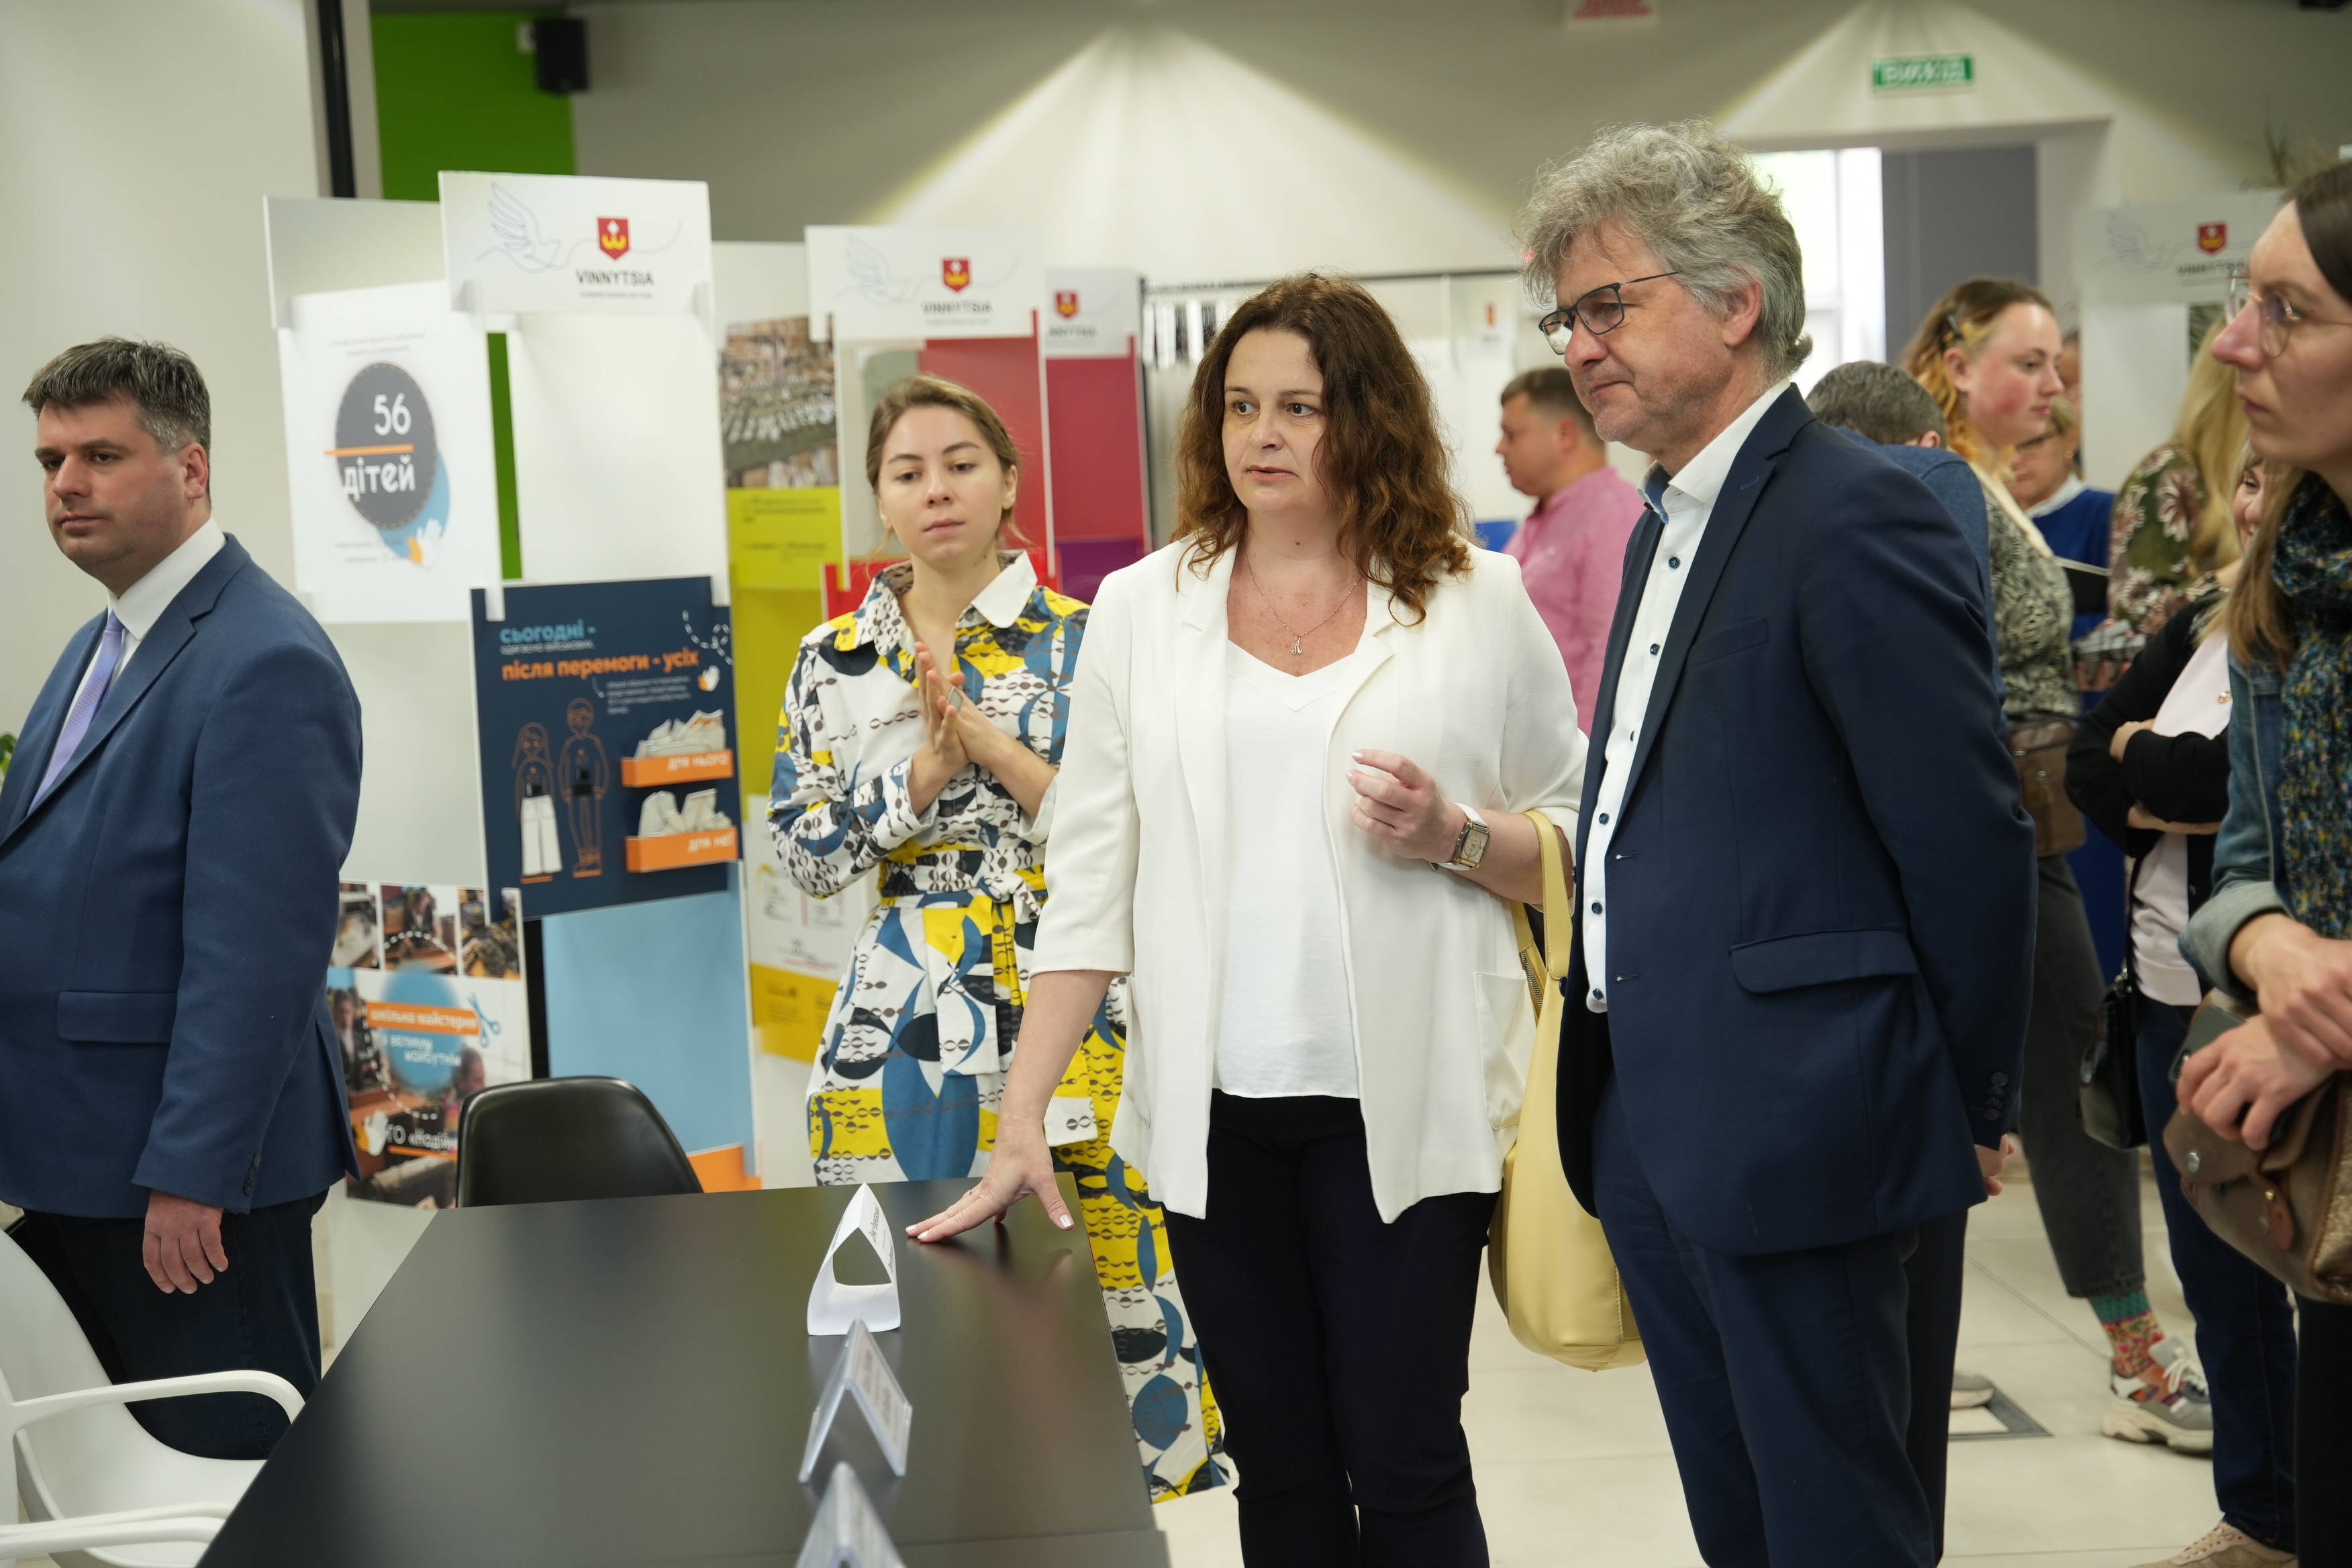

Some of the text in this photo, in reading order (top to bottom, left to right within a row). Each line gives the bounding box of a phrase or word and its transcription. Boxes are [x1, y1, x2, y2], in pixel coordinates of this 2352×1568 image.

[575, 268, 654, 285] VINNYTSIA
[374, 392, 411, 436] 56
[344, 454, 415, 502] дітей
[499, 618, 584, 644] сьогодні
[501, 659, 554, 681] після
[557, 654, 649, 680] перемоги
[663, 646, 699, 673] усіх
